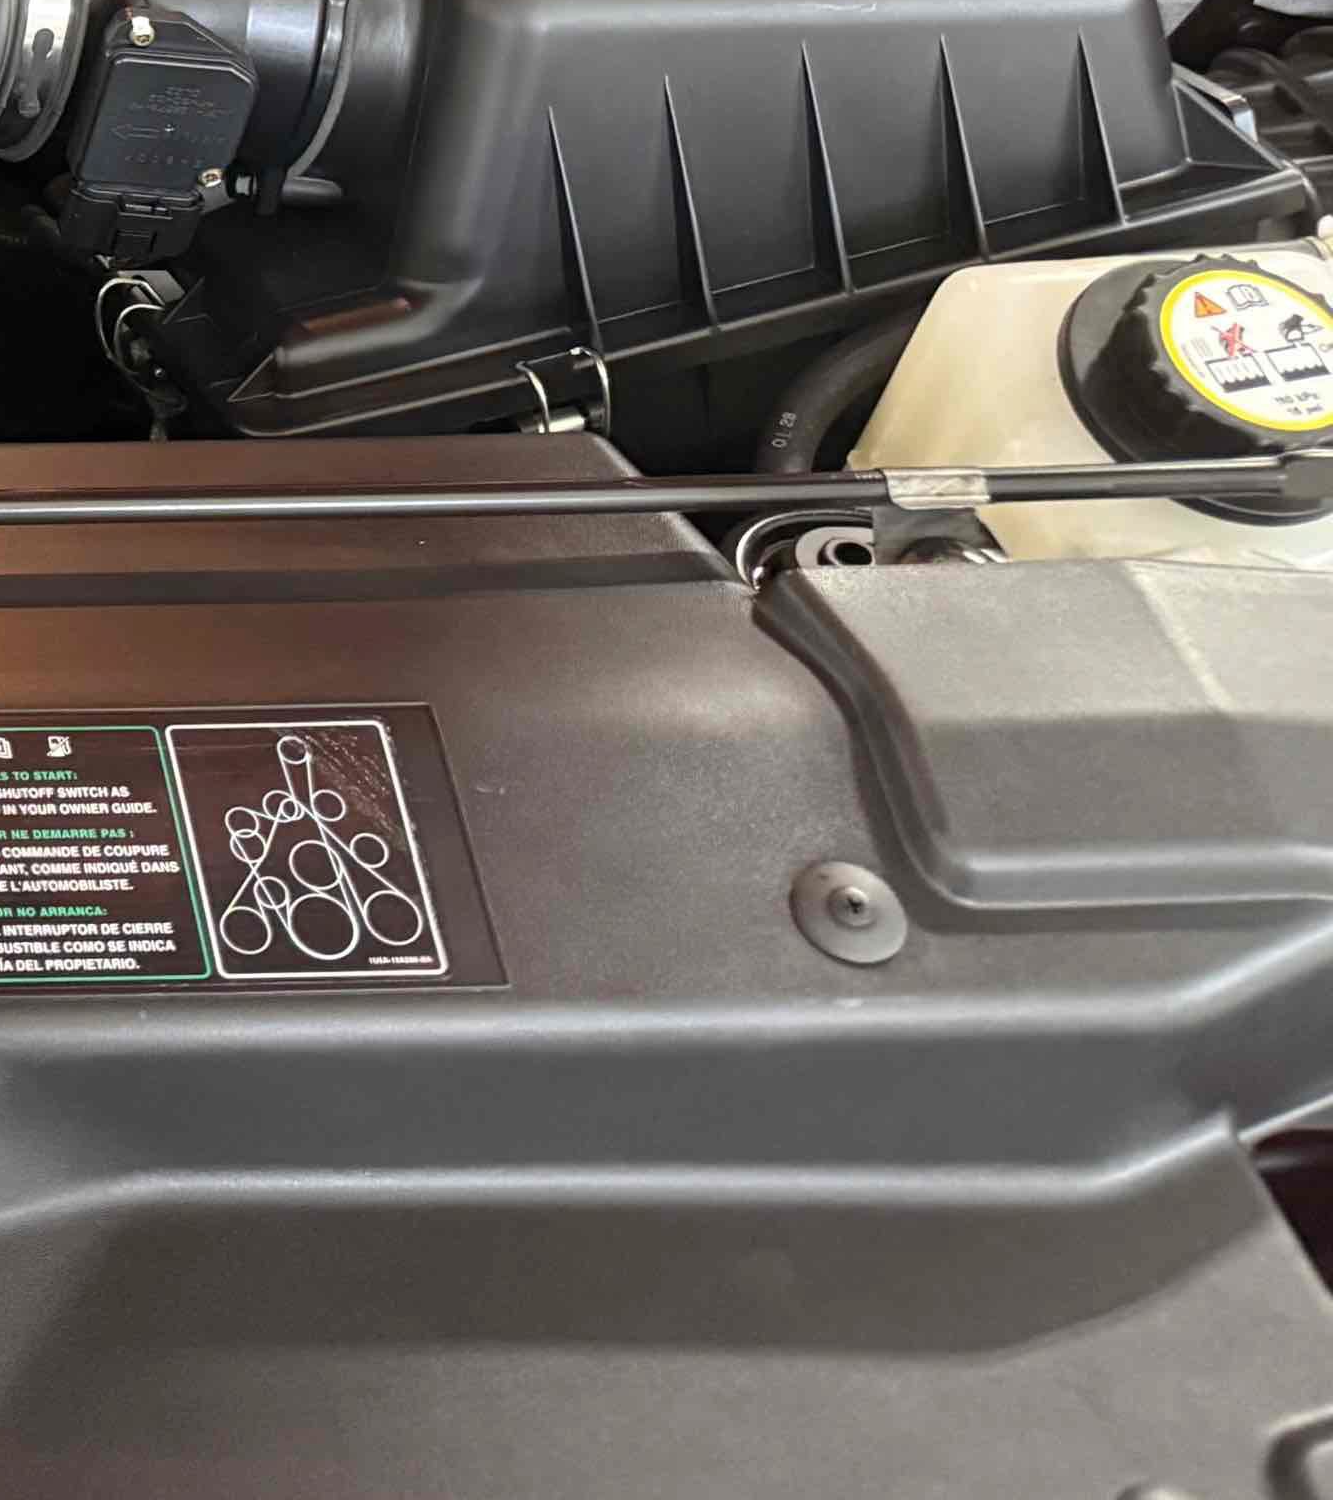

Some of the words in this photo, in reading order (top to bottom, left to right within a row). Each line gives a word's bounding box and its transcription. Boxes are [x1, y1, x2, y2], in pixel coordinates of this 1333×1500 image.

[12, 771, 29, 780] TO
[33, 770, 77, 780] START:
[56, 786, 109, 798] SWITCH
[110, 786, 130, 797] AS
[2, 804, 17, 815] IN
[18, 803, 57, 815] YOUR
[59, 802, 109, 815] OWNER
[111, 802, 157, 814] GUIDE.
